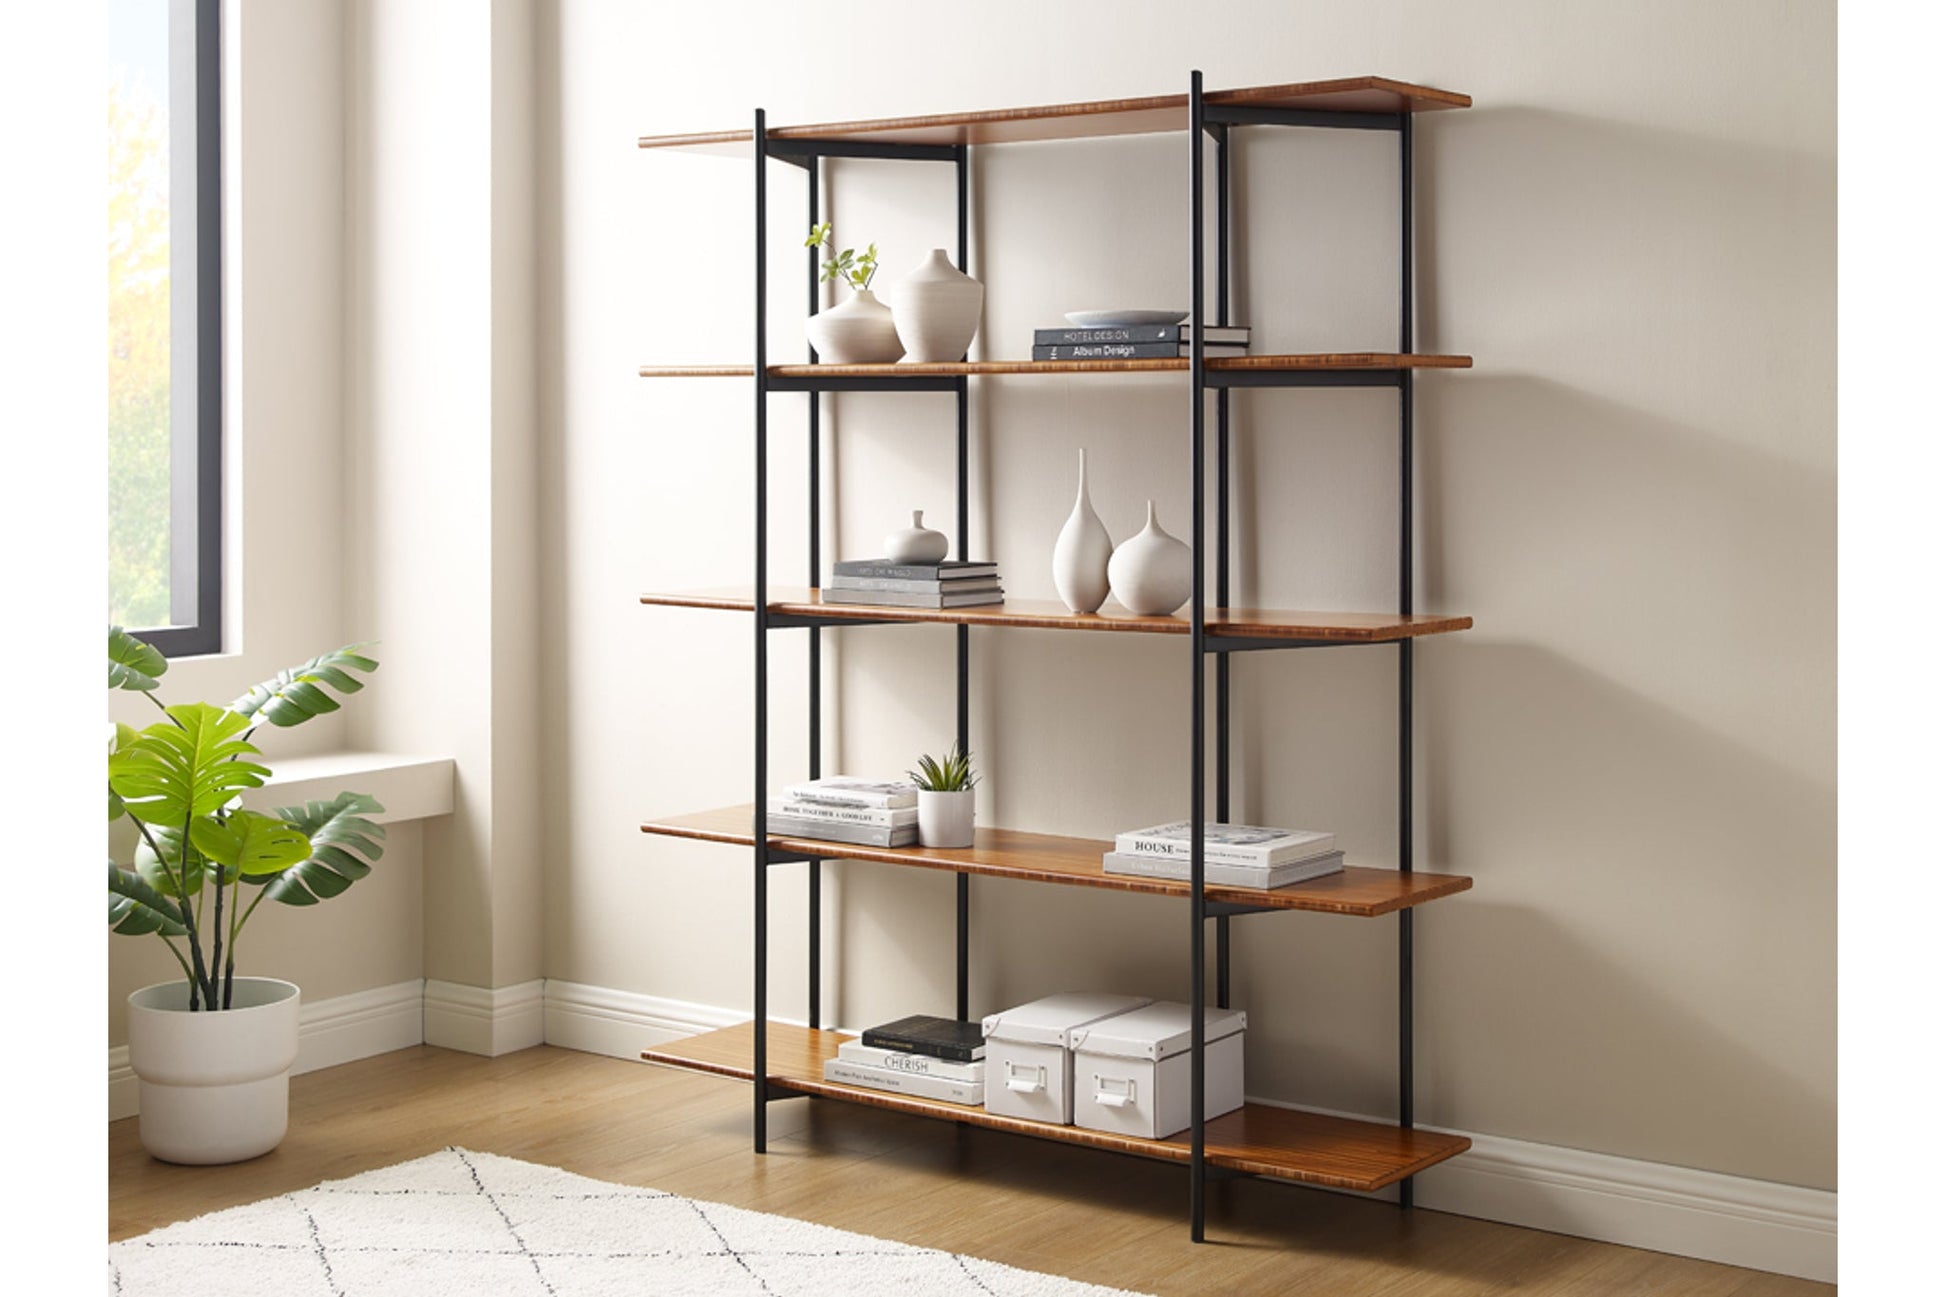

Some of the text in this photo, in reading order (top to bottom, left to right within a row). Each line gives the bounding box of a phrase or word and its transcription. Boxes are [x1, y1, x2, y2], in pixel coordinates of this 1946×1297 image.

[1072, 345, 1135, 358] Album Design
[1134, 841, 1174, 854] HOUSE
[884, 1056, 929, 1072] CHERISH
